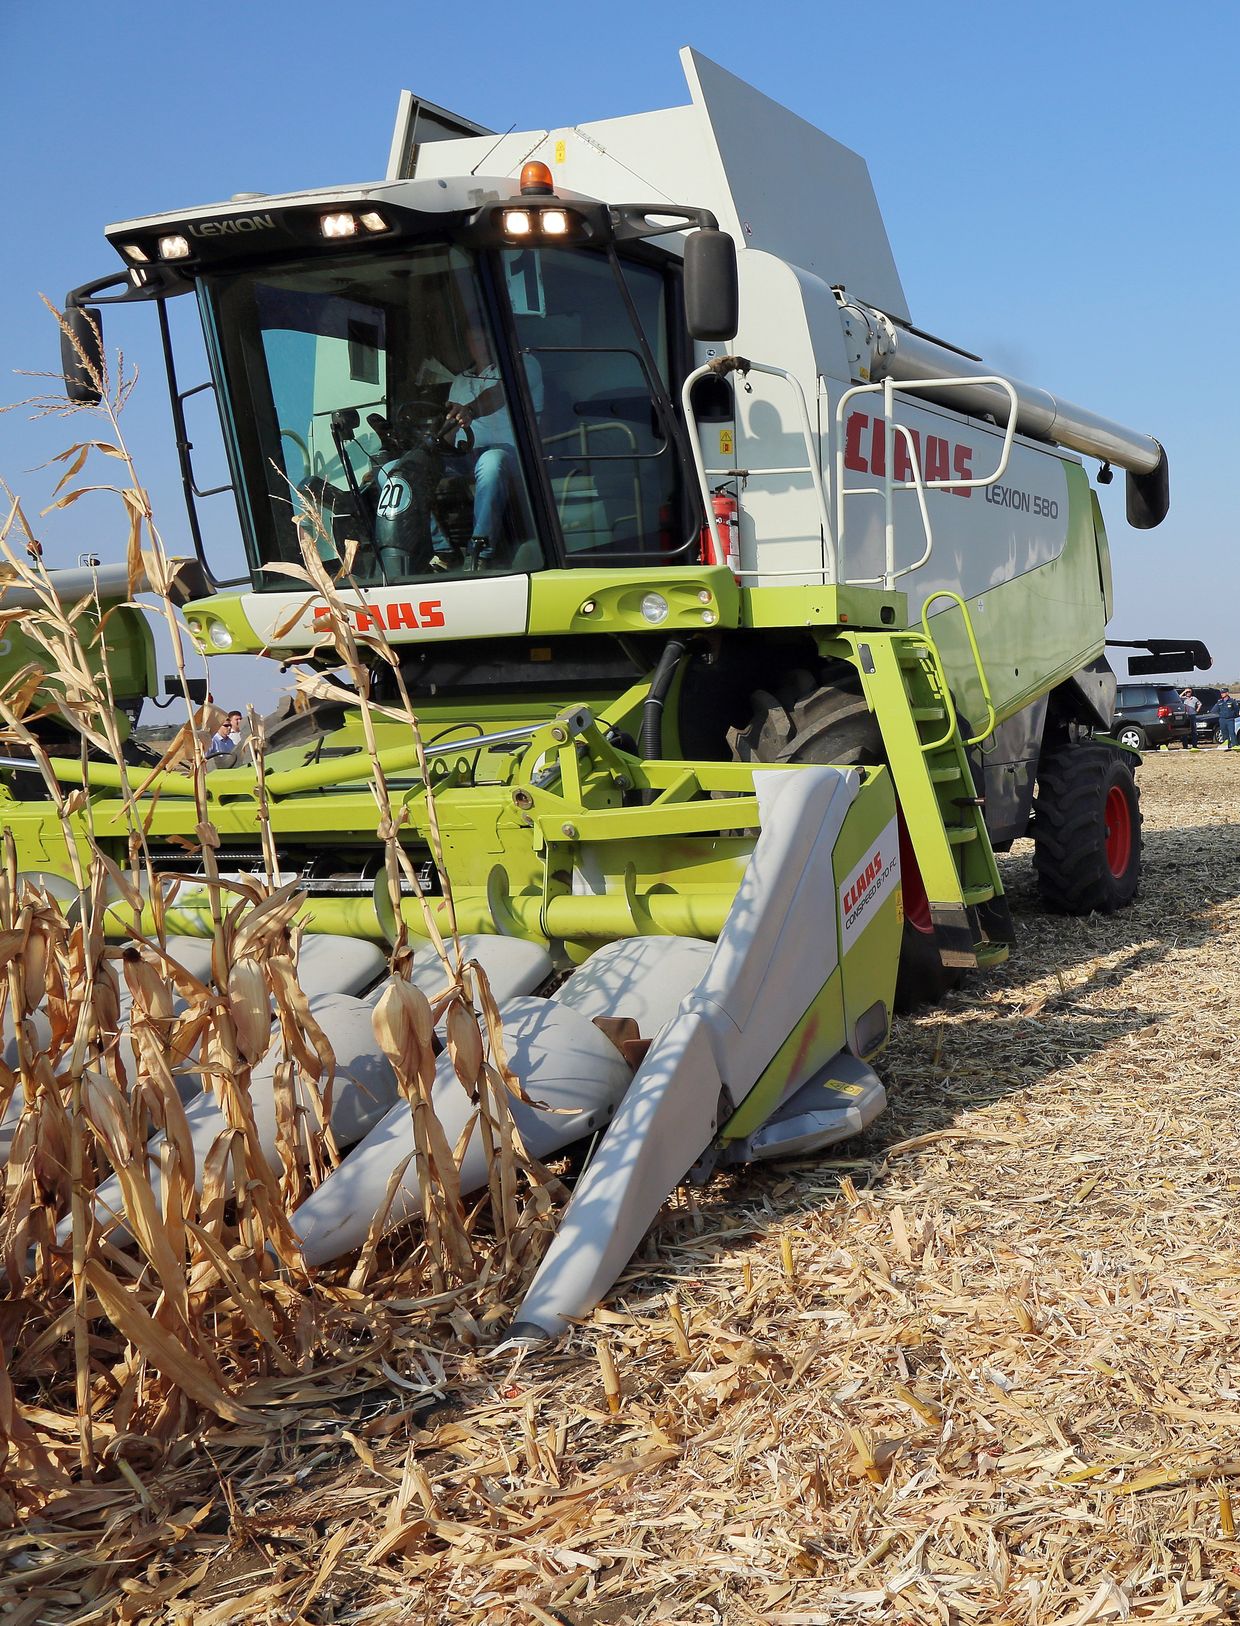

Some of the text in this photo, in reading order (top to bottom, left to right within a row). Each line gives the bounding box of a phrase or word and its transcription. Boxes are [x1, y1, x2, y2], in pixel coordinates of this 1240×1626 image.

[188, 214, 276, 238] LEXION
[844, 411, 973, 498] CLAAS
[379, 484, 404, 510] 20
[985, 485, 1058, 520] LEXION 580
[843, 850, 882, 916] CLAAS
[845, 885, 877, 930] CONSPEED
